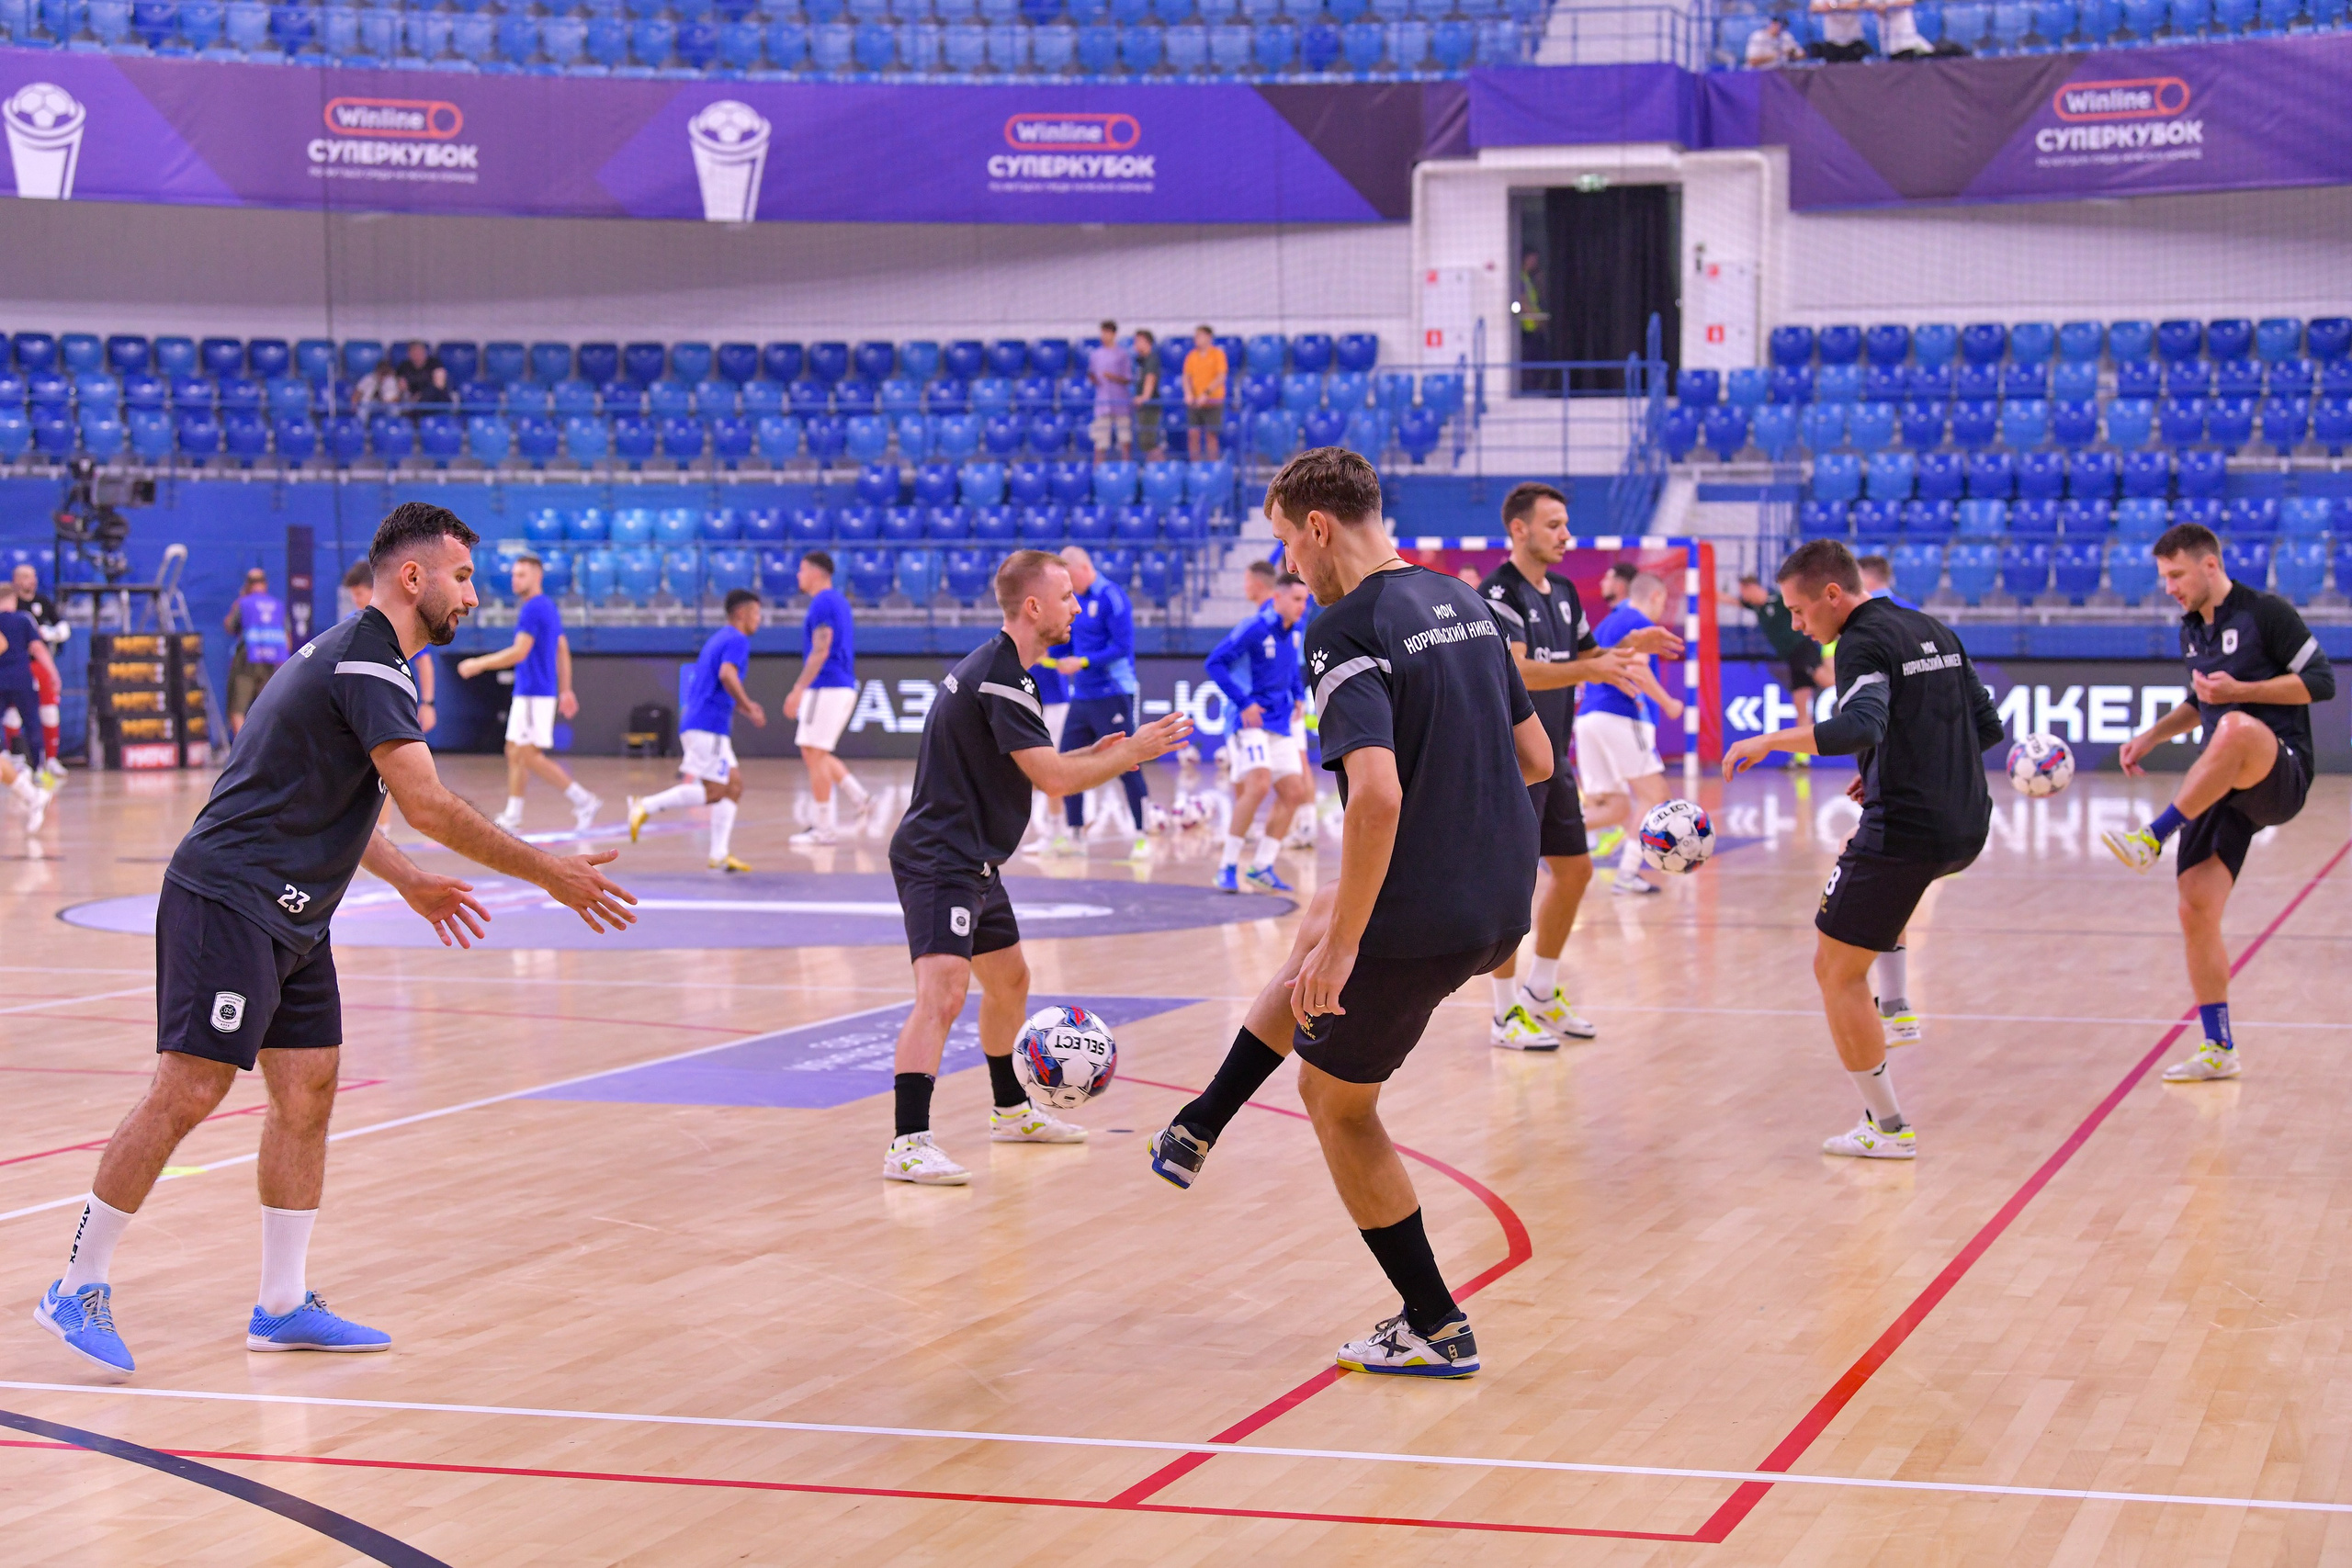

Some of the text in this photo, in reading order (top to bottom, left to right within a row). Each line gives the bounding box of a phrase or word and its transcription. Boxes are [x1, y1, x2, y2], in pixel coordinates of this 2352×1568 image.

[2066, 88, 2152, 113] Winline
[335, 105, 425, 130] Winline
[1016, 121, 1102, 143] Winline
[2035, 119, 2203, 152] СУПЕРКУБОК
[307, 138, 479, 168] СУПЕРКУБОК
[987, 154, 1156, 178] СУПЕРКУБОК
[1432, 603, 1457, 620] МФК
[1403, 622, 1468, 655] НОРИЛЬСКИЙ
[1653, 804, 1689, 826] SELECT
[277, 883, 311, 913] 23
[1055, 1034, 1105, 1055] SELECT
[1300, 1024, 1317, 1041] ELME
